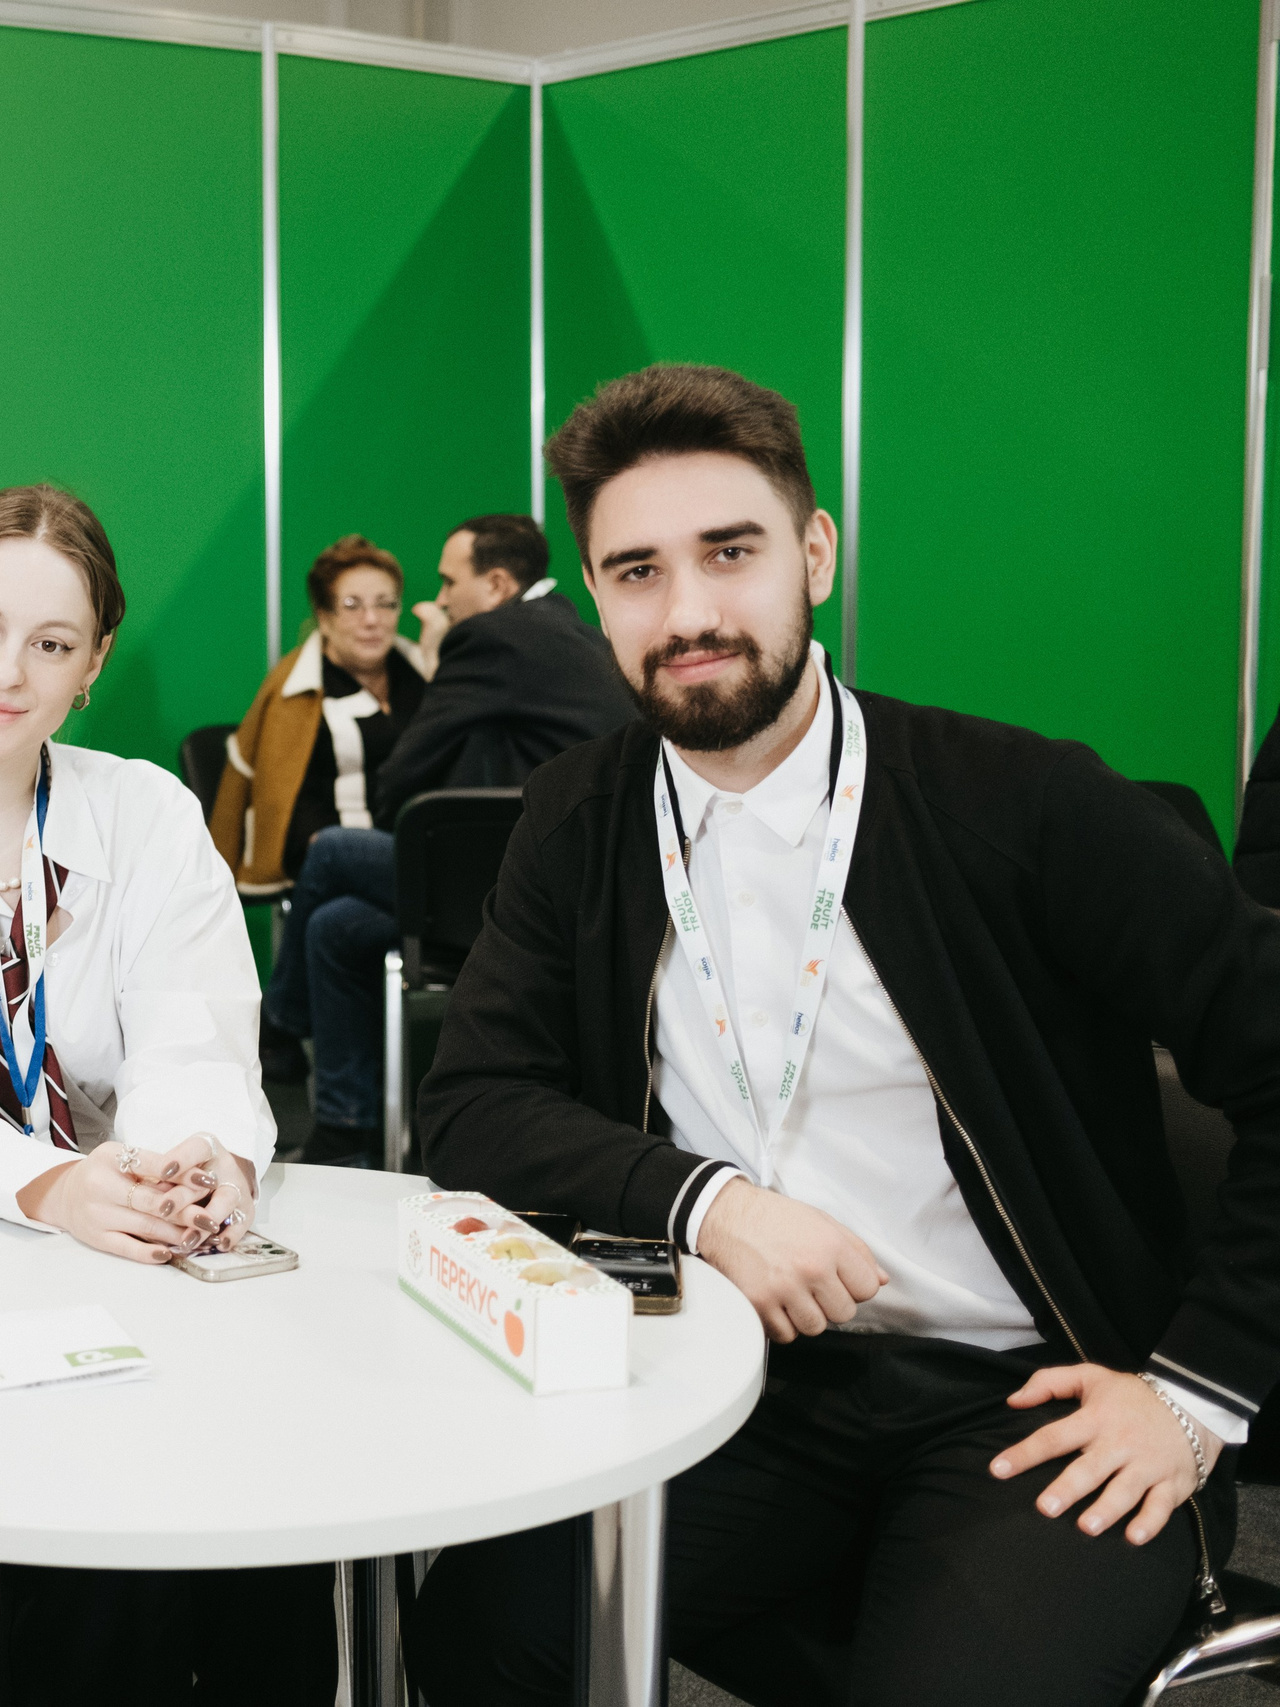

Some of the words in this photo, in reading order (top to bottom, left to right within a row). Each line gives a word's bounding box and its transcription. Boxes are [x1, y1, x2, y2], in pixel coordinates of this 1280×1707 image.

[829, 837, 841, 862] helios
[681, 889, 700, 932] TRADE
[810, 888, 827, 931] TRADE
[25, 922, 35, 959] TRADE
[701, 957, 712, 981] helios
[794, 1011, 804, 1036] helios
[779, 1059, 791, 1100] TRADE
[429, 1245, 499, 1326] ПЕРЕКУС
